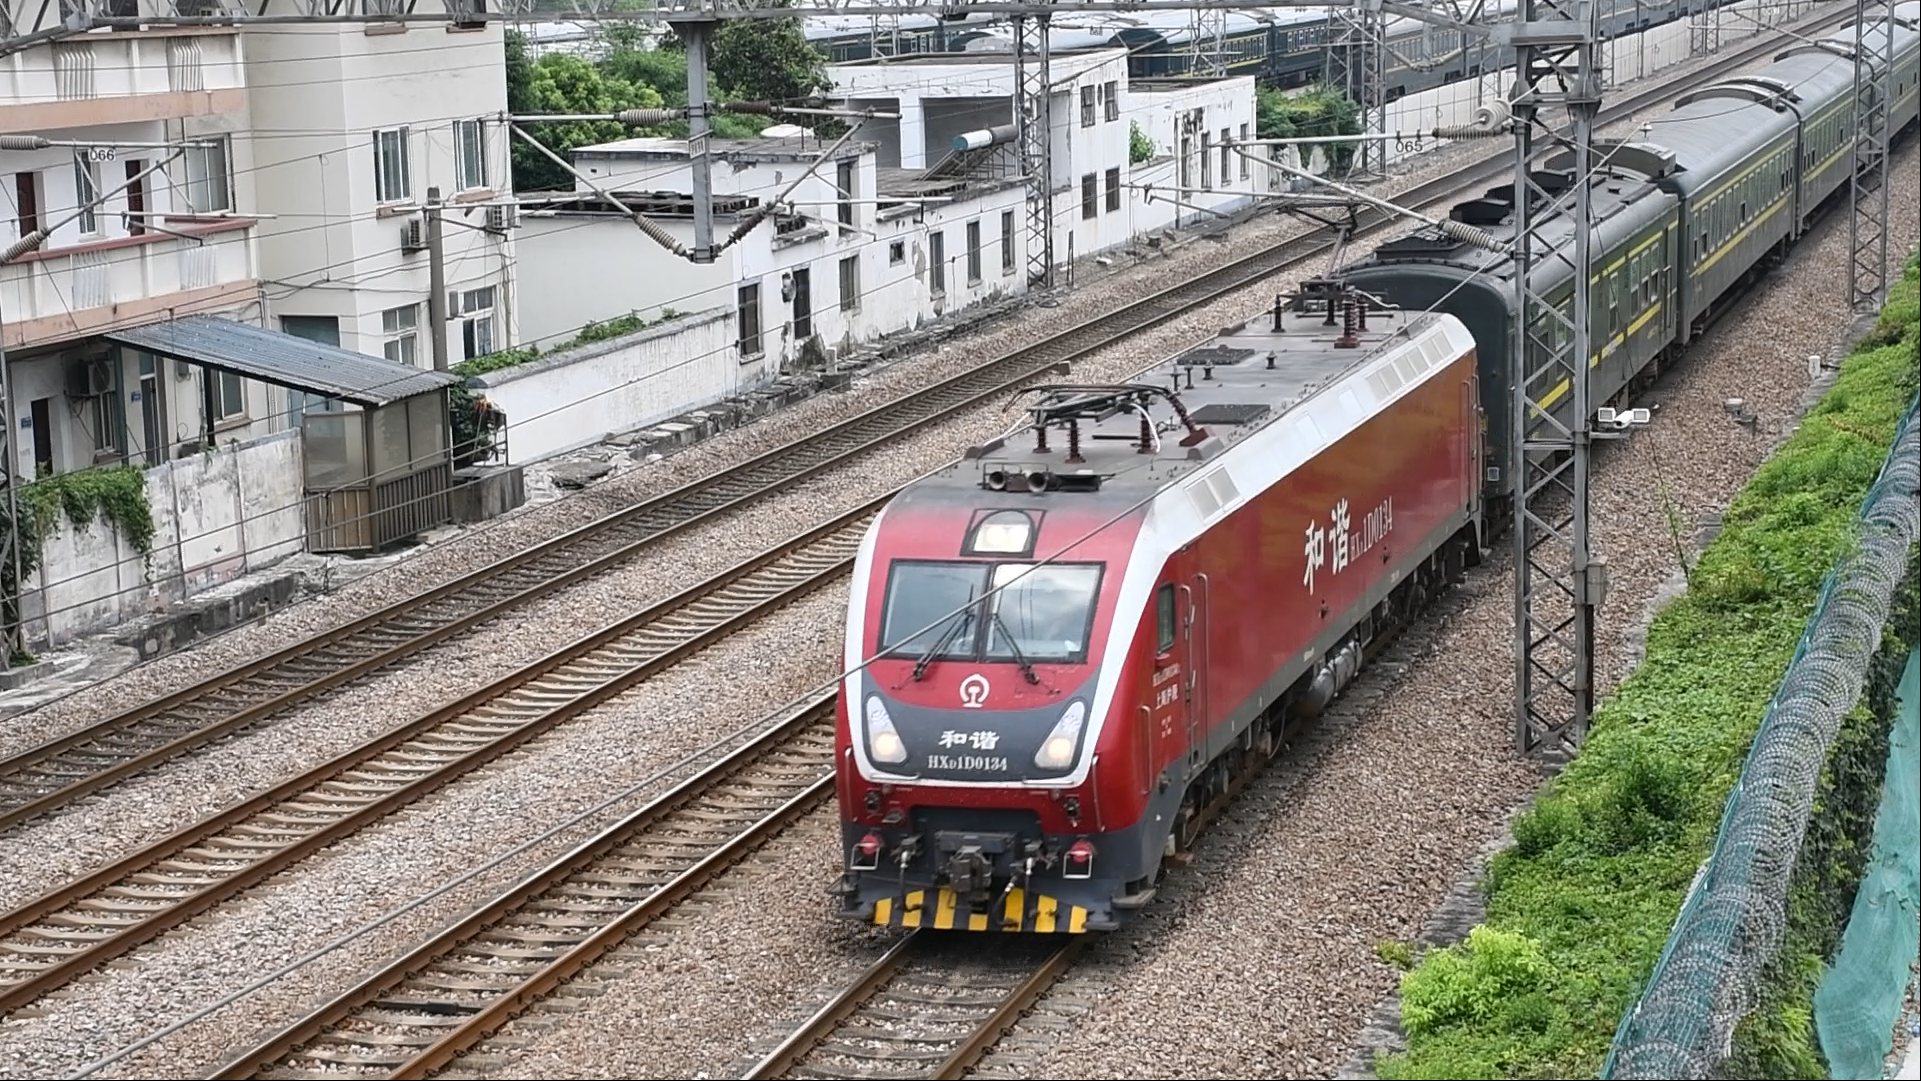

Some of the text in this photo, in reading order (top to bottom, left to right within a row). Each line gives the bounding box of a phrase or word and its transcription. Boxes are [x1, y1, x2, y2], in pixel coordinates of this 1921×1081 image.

[90, 149, 115, 161] 066
[1395, 140, 1423, 153] 065
[1303, 497, 1351, 596] 和谐
[938, 730, 1000, 750] 和谐
[927, 754, 1008, 771] HXD1D0134
